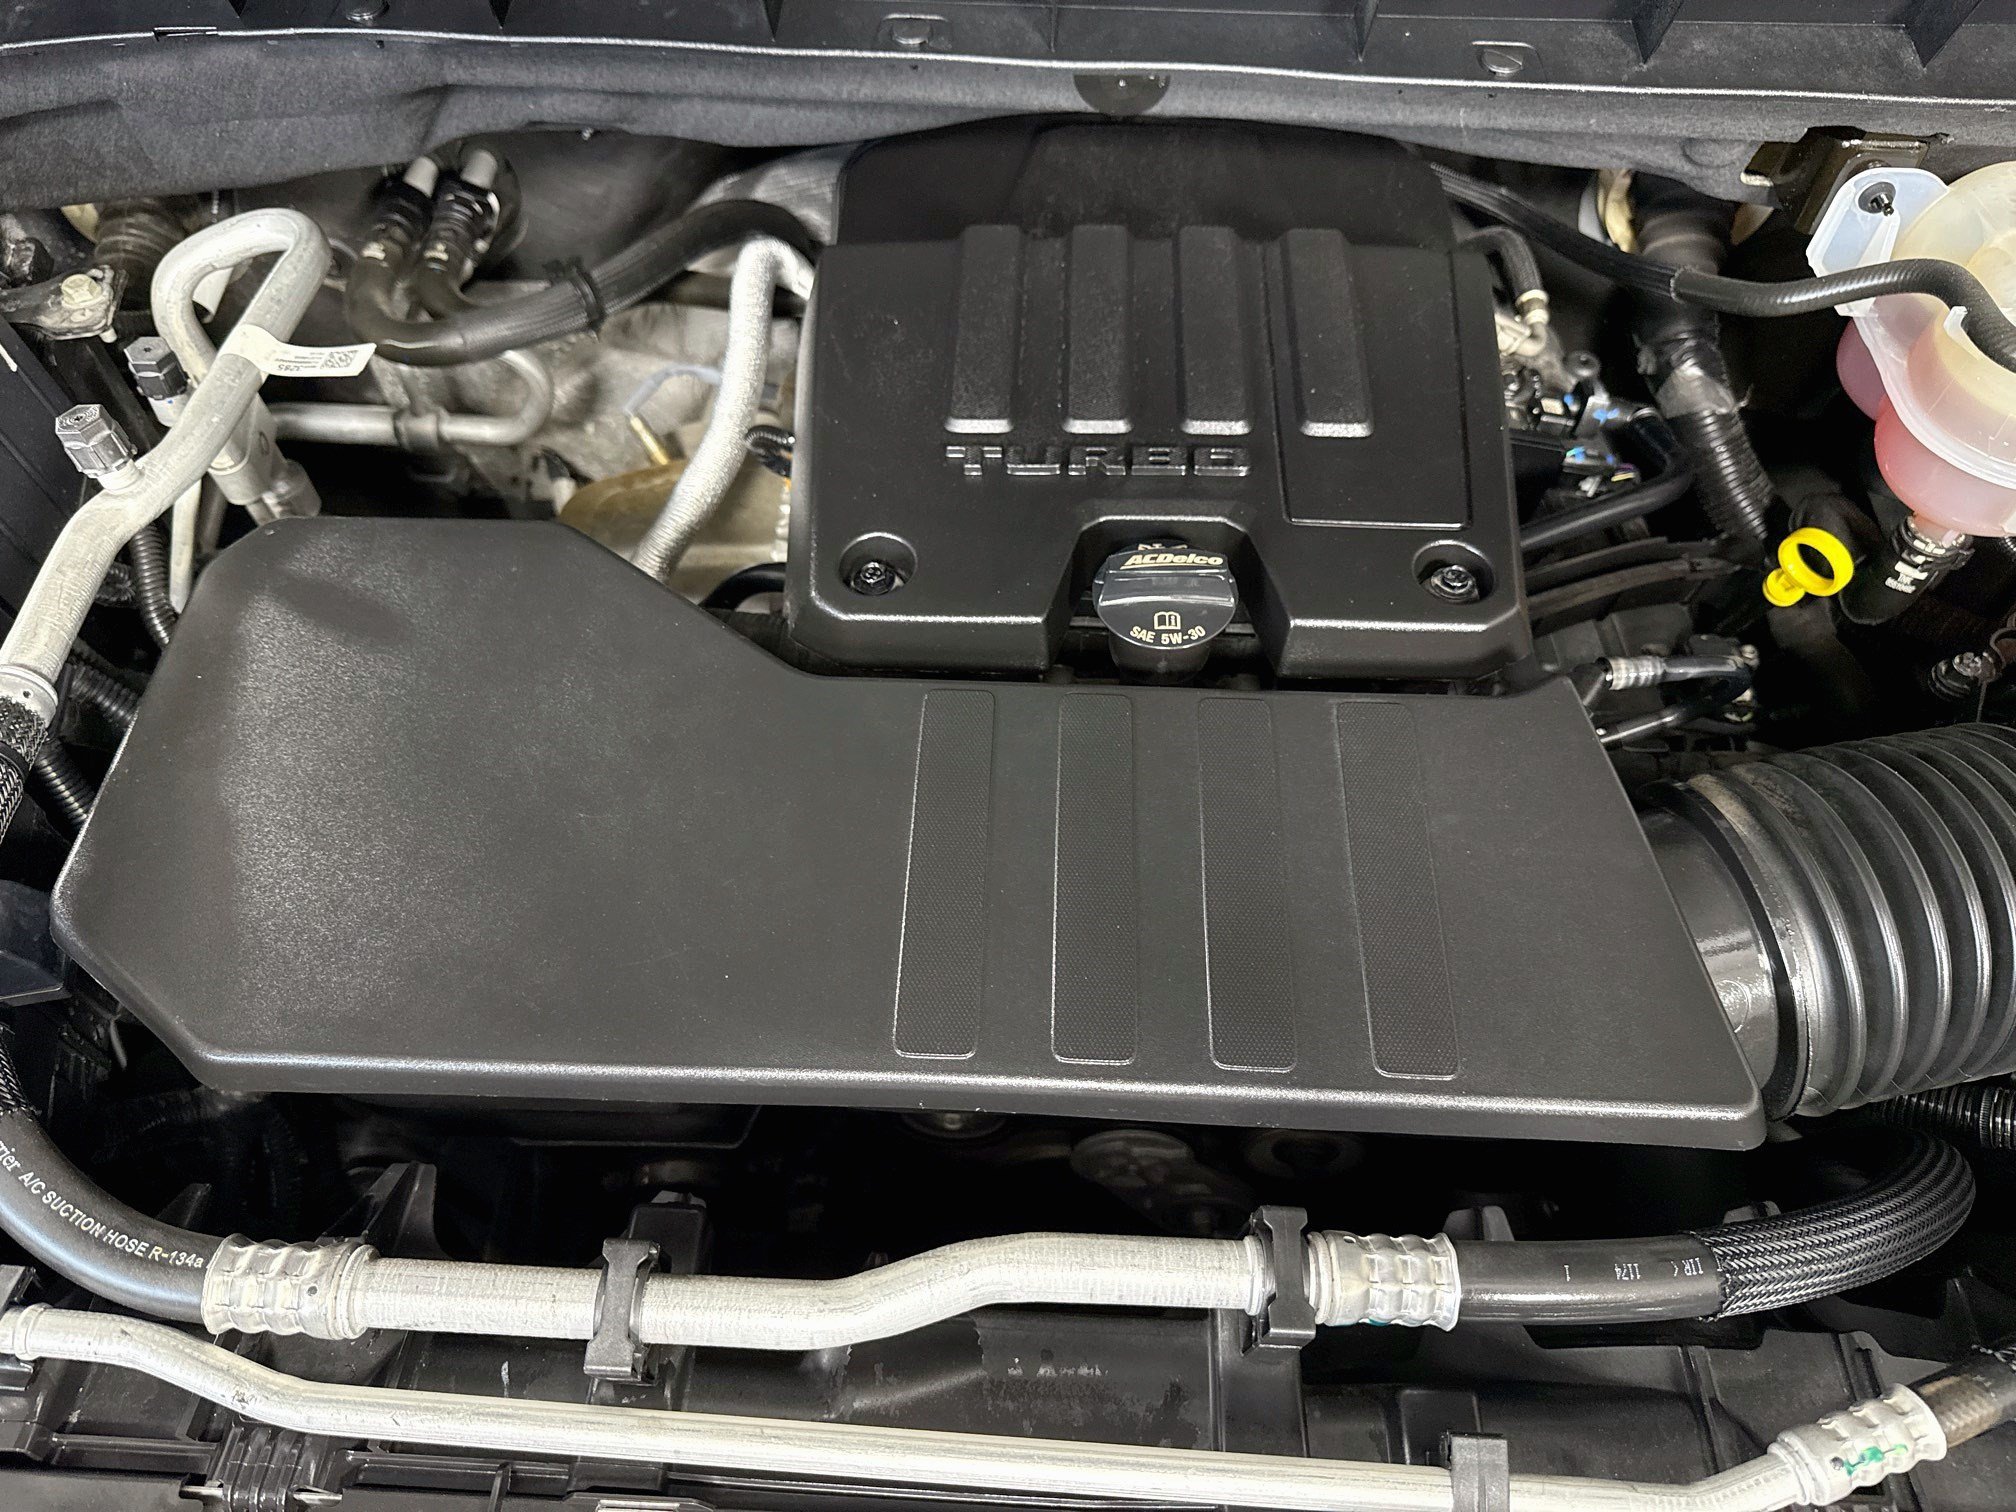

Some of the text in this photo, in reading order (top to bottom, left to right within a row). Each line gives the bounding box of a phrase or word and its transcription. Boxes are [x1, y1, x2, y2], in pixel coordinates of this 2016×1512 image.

[946, 445, 1250, 476] TURBO
[1124, 553, 1224, 567] ACDelco
[1129, 625, 1206, 645] SAE 5W-30
[18, 1171, 46, 1195] A/C
[41, 1190, 106, 1238] SUCTION
[103, 1229, 150, 1257] HOSE
[148, 1246, 204, 1269] R-134a
